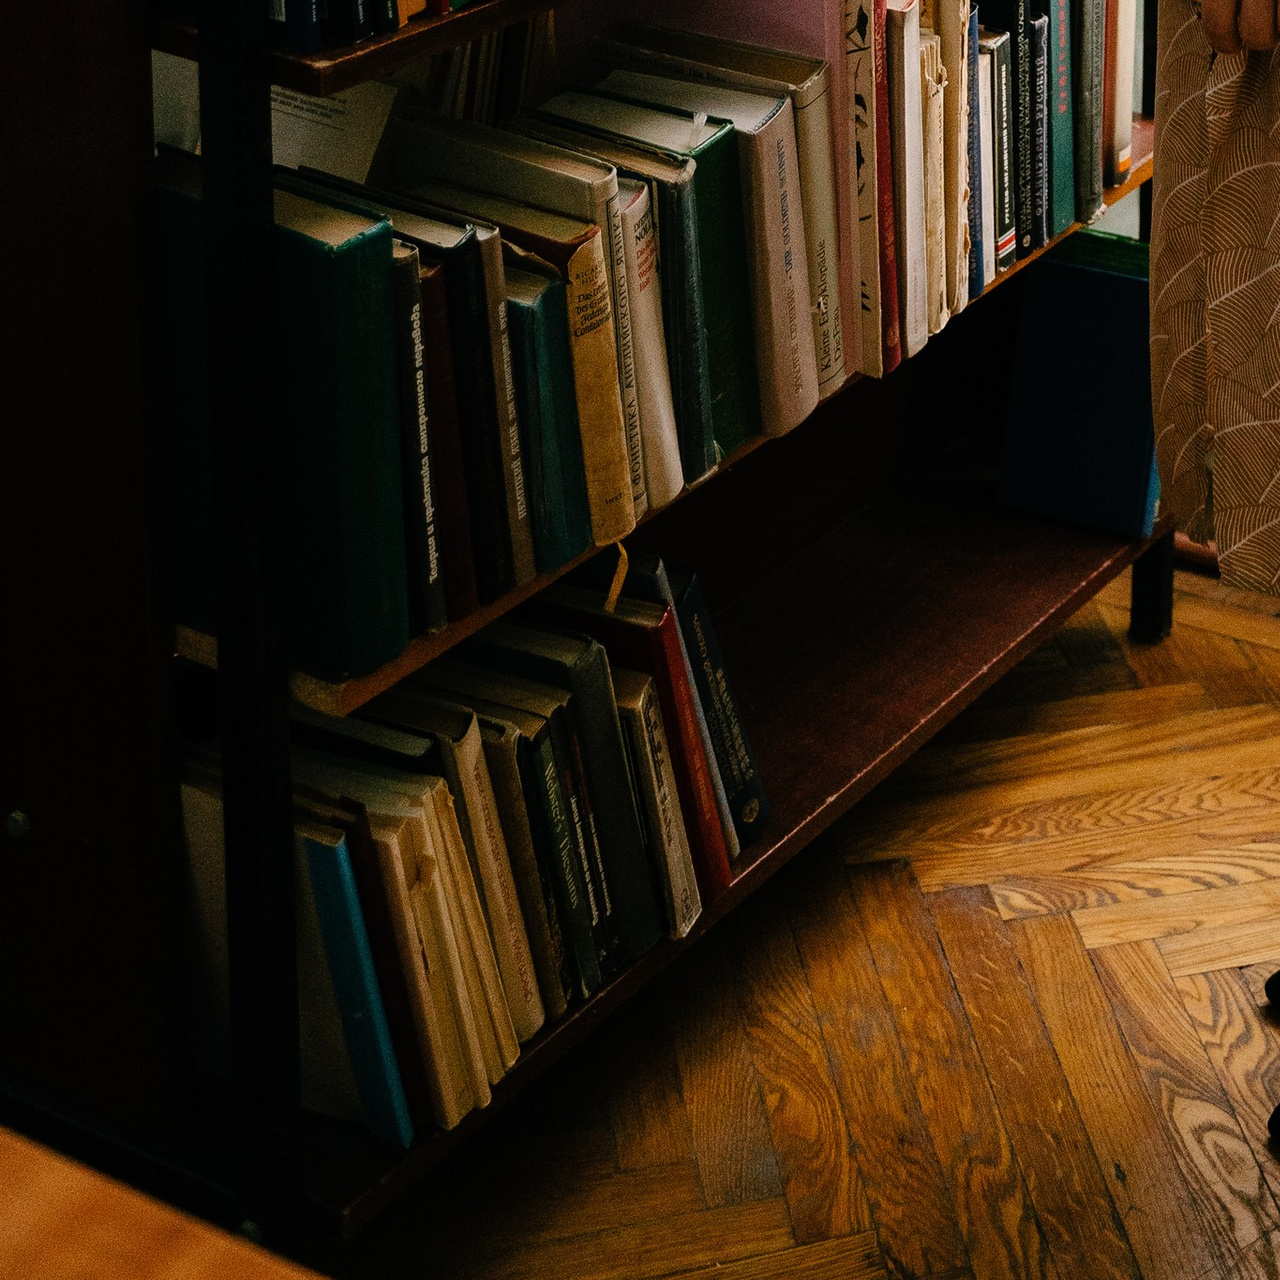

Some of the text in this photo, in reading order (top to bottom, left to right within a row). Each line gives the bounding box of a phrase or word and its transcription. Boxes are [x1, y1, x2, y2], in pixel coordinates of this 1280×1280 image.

[776, 138, 785, 188] SCHNITT
[1033, 56, 1045, 215] ФРАНЦУЗСКО-РУССКИЙ
[780, 191, 790, 245] GOLDENE
[784, 248, 792, 273] DER
[612, 208, 641, 485] ФОНЕТИКА АНГЛИЙСКОГО ЯЗЫКА
[819, 329, 830, 372] Kleine
[832, 306, 842, 361] Die Frau
[410, 303, 440, 582] Теория и практика синхронного перевода
[508, 422, 520, 455] ЯЗЫК
[511, 456, 527, 519] НЕМЕЦКИЙ
[542, 762, 581, 909] Webster's Thesaurus
